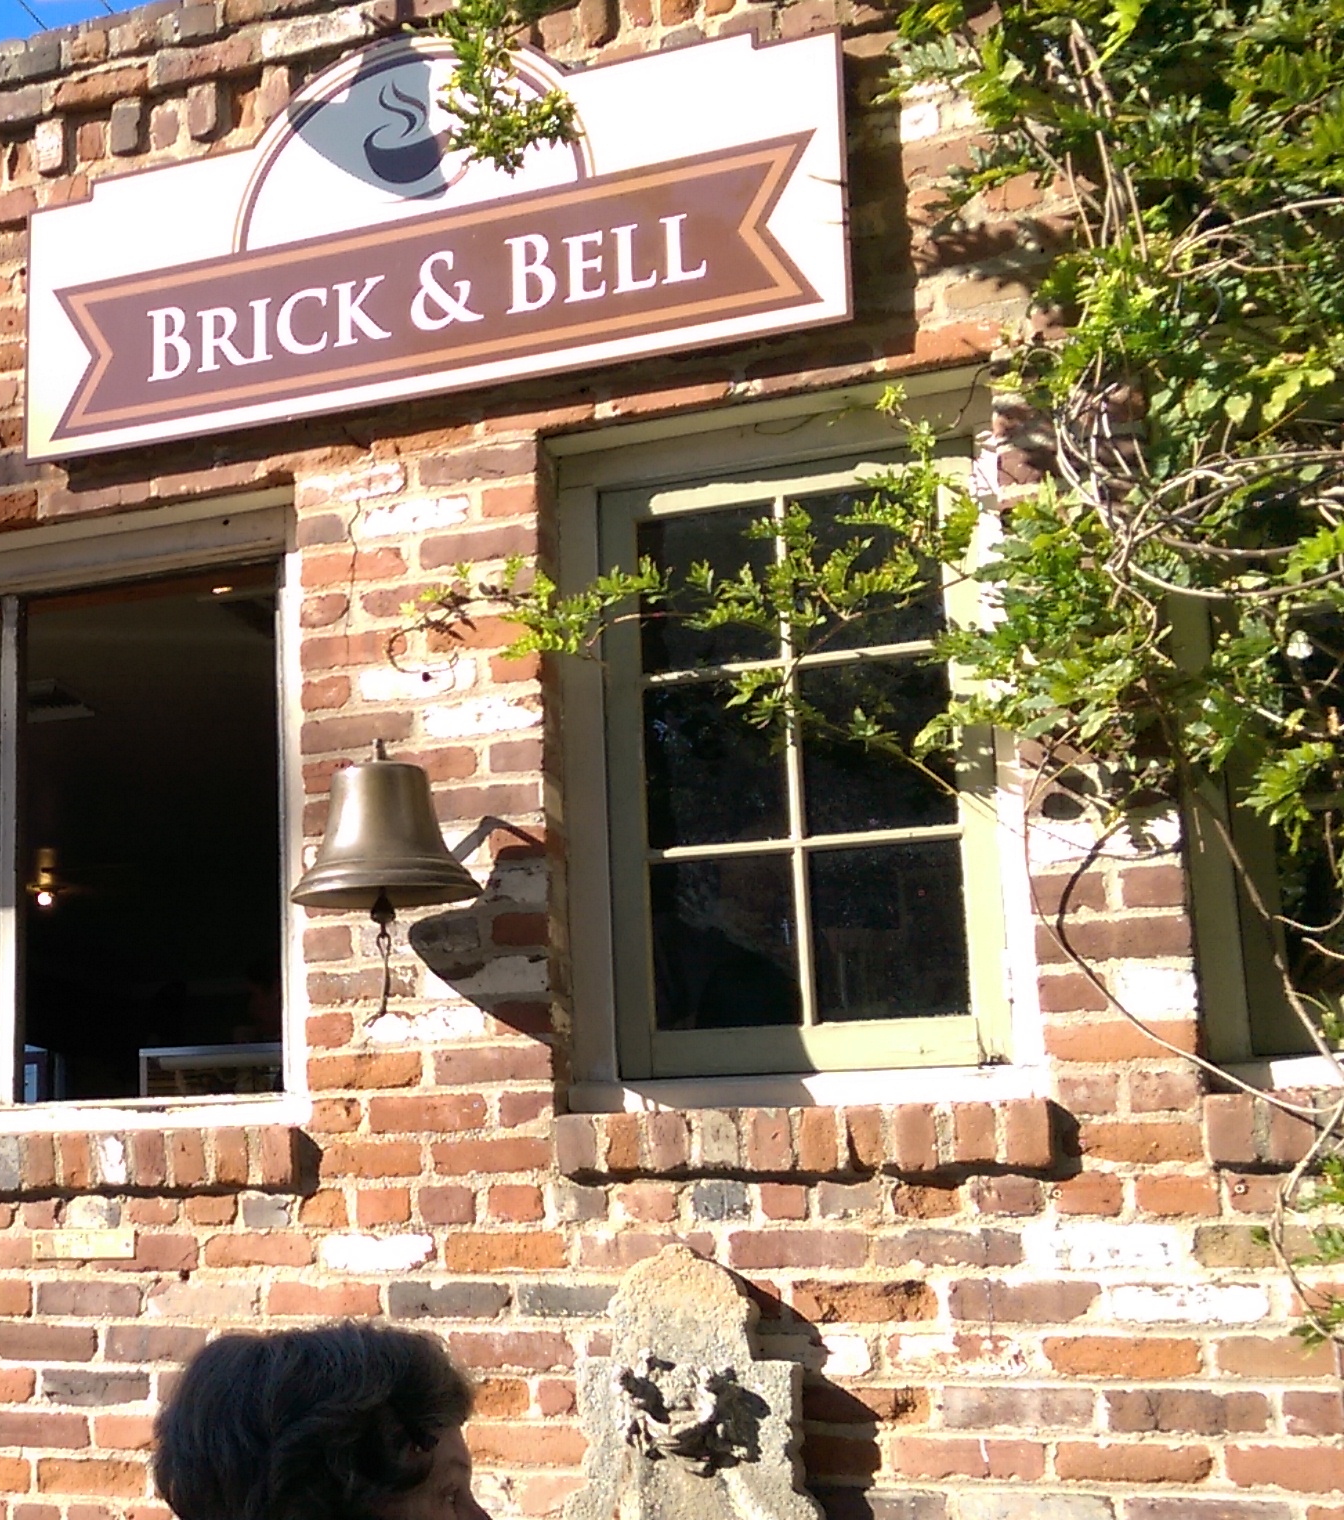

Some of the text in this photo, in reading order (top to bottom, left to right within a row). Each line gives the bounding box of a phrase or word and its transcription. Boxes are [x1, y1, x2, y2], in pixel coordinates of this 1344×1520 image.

[145, 212, 708, 384] BRICK & BELL
